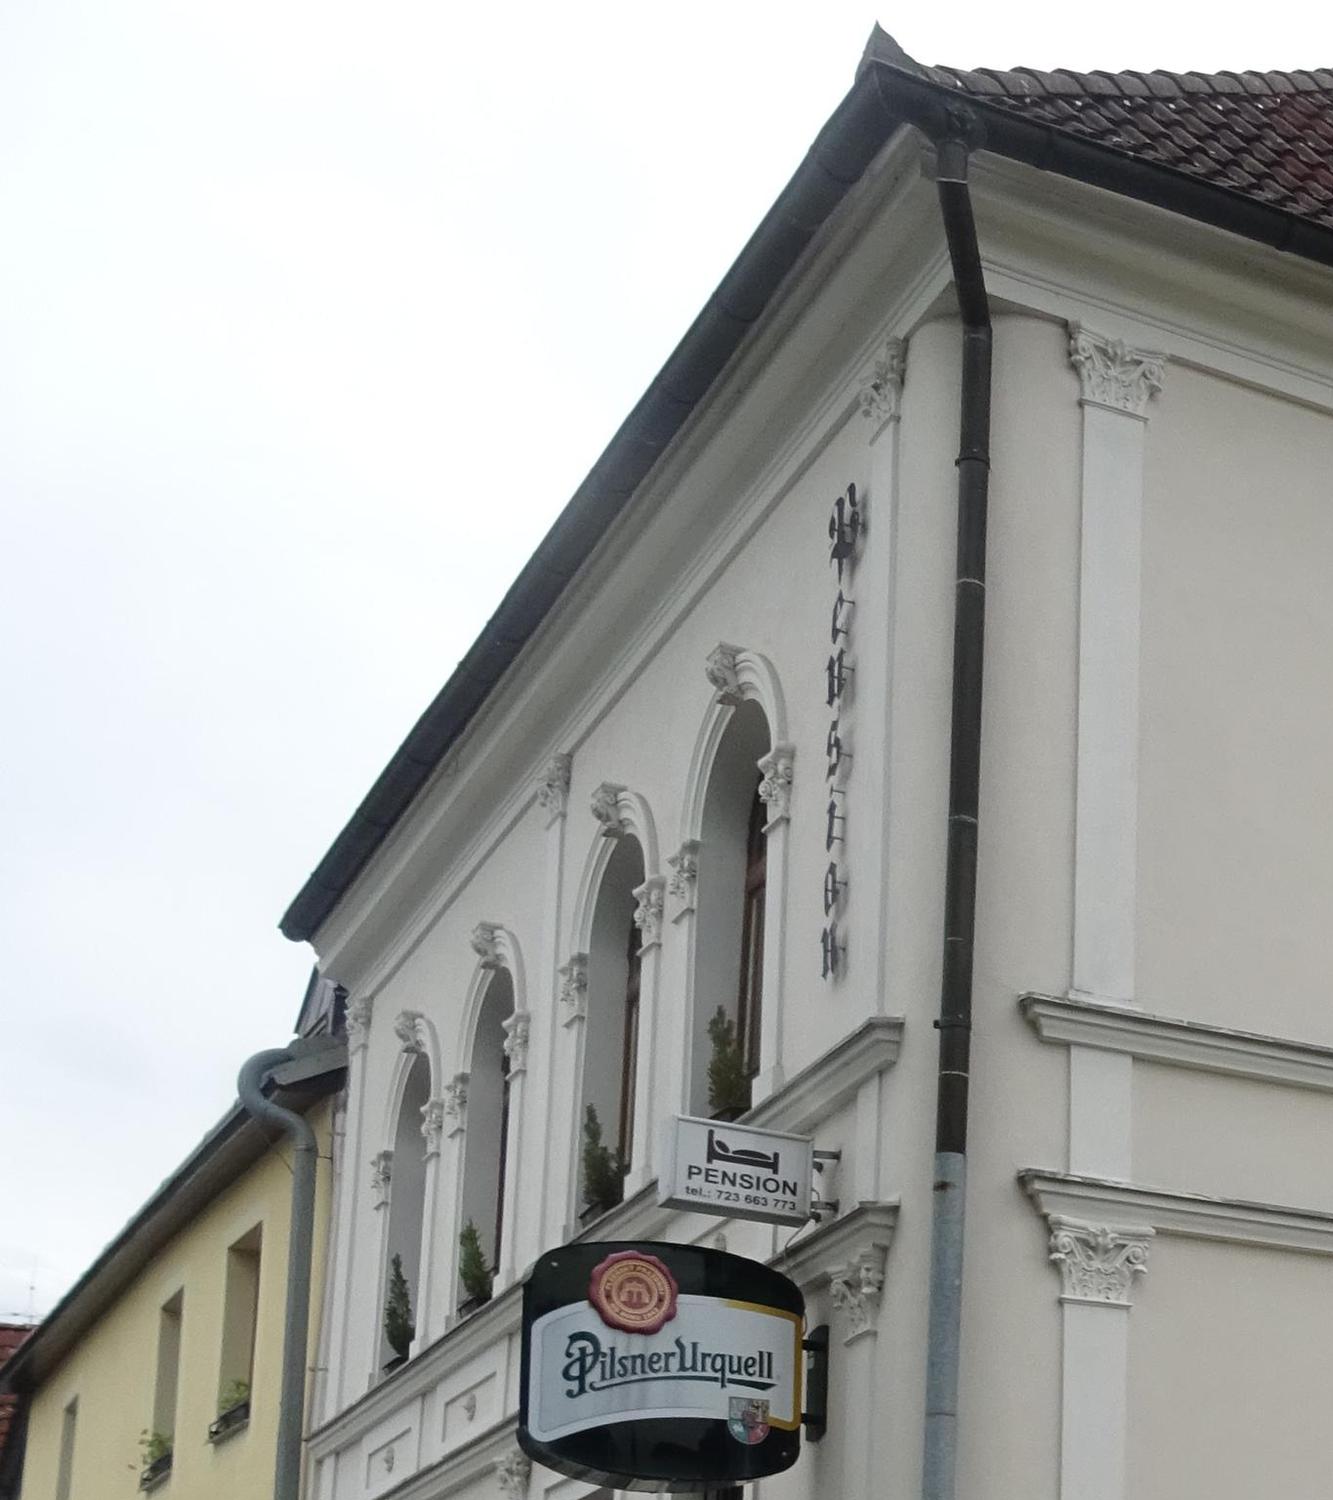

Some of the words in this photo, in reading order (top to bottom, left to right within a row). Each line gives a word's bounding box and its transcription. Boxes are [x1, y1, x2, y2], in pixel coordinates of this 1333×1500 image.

[687, 1164, 798, 1197] PENSION
[685, 1185, 712, 1198] tel.:
[716, 1189, 740, 1203] 723
[744, 1194, 769, 1207] 663
[773, 1198, 797, 1211] 773
[561, 1331, 676, 1398] Pilsner
[674, 1336, 774, 1389] Urquell
